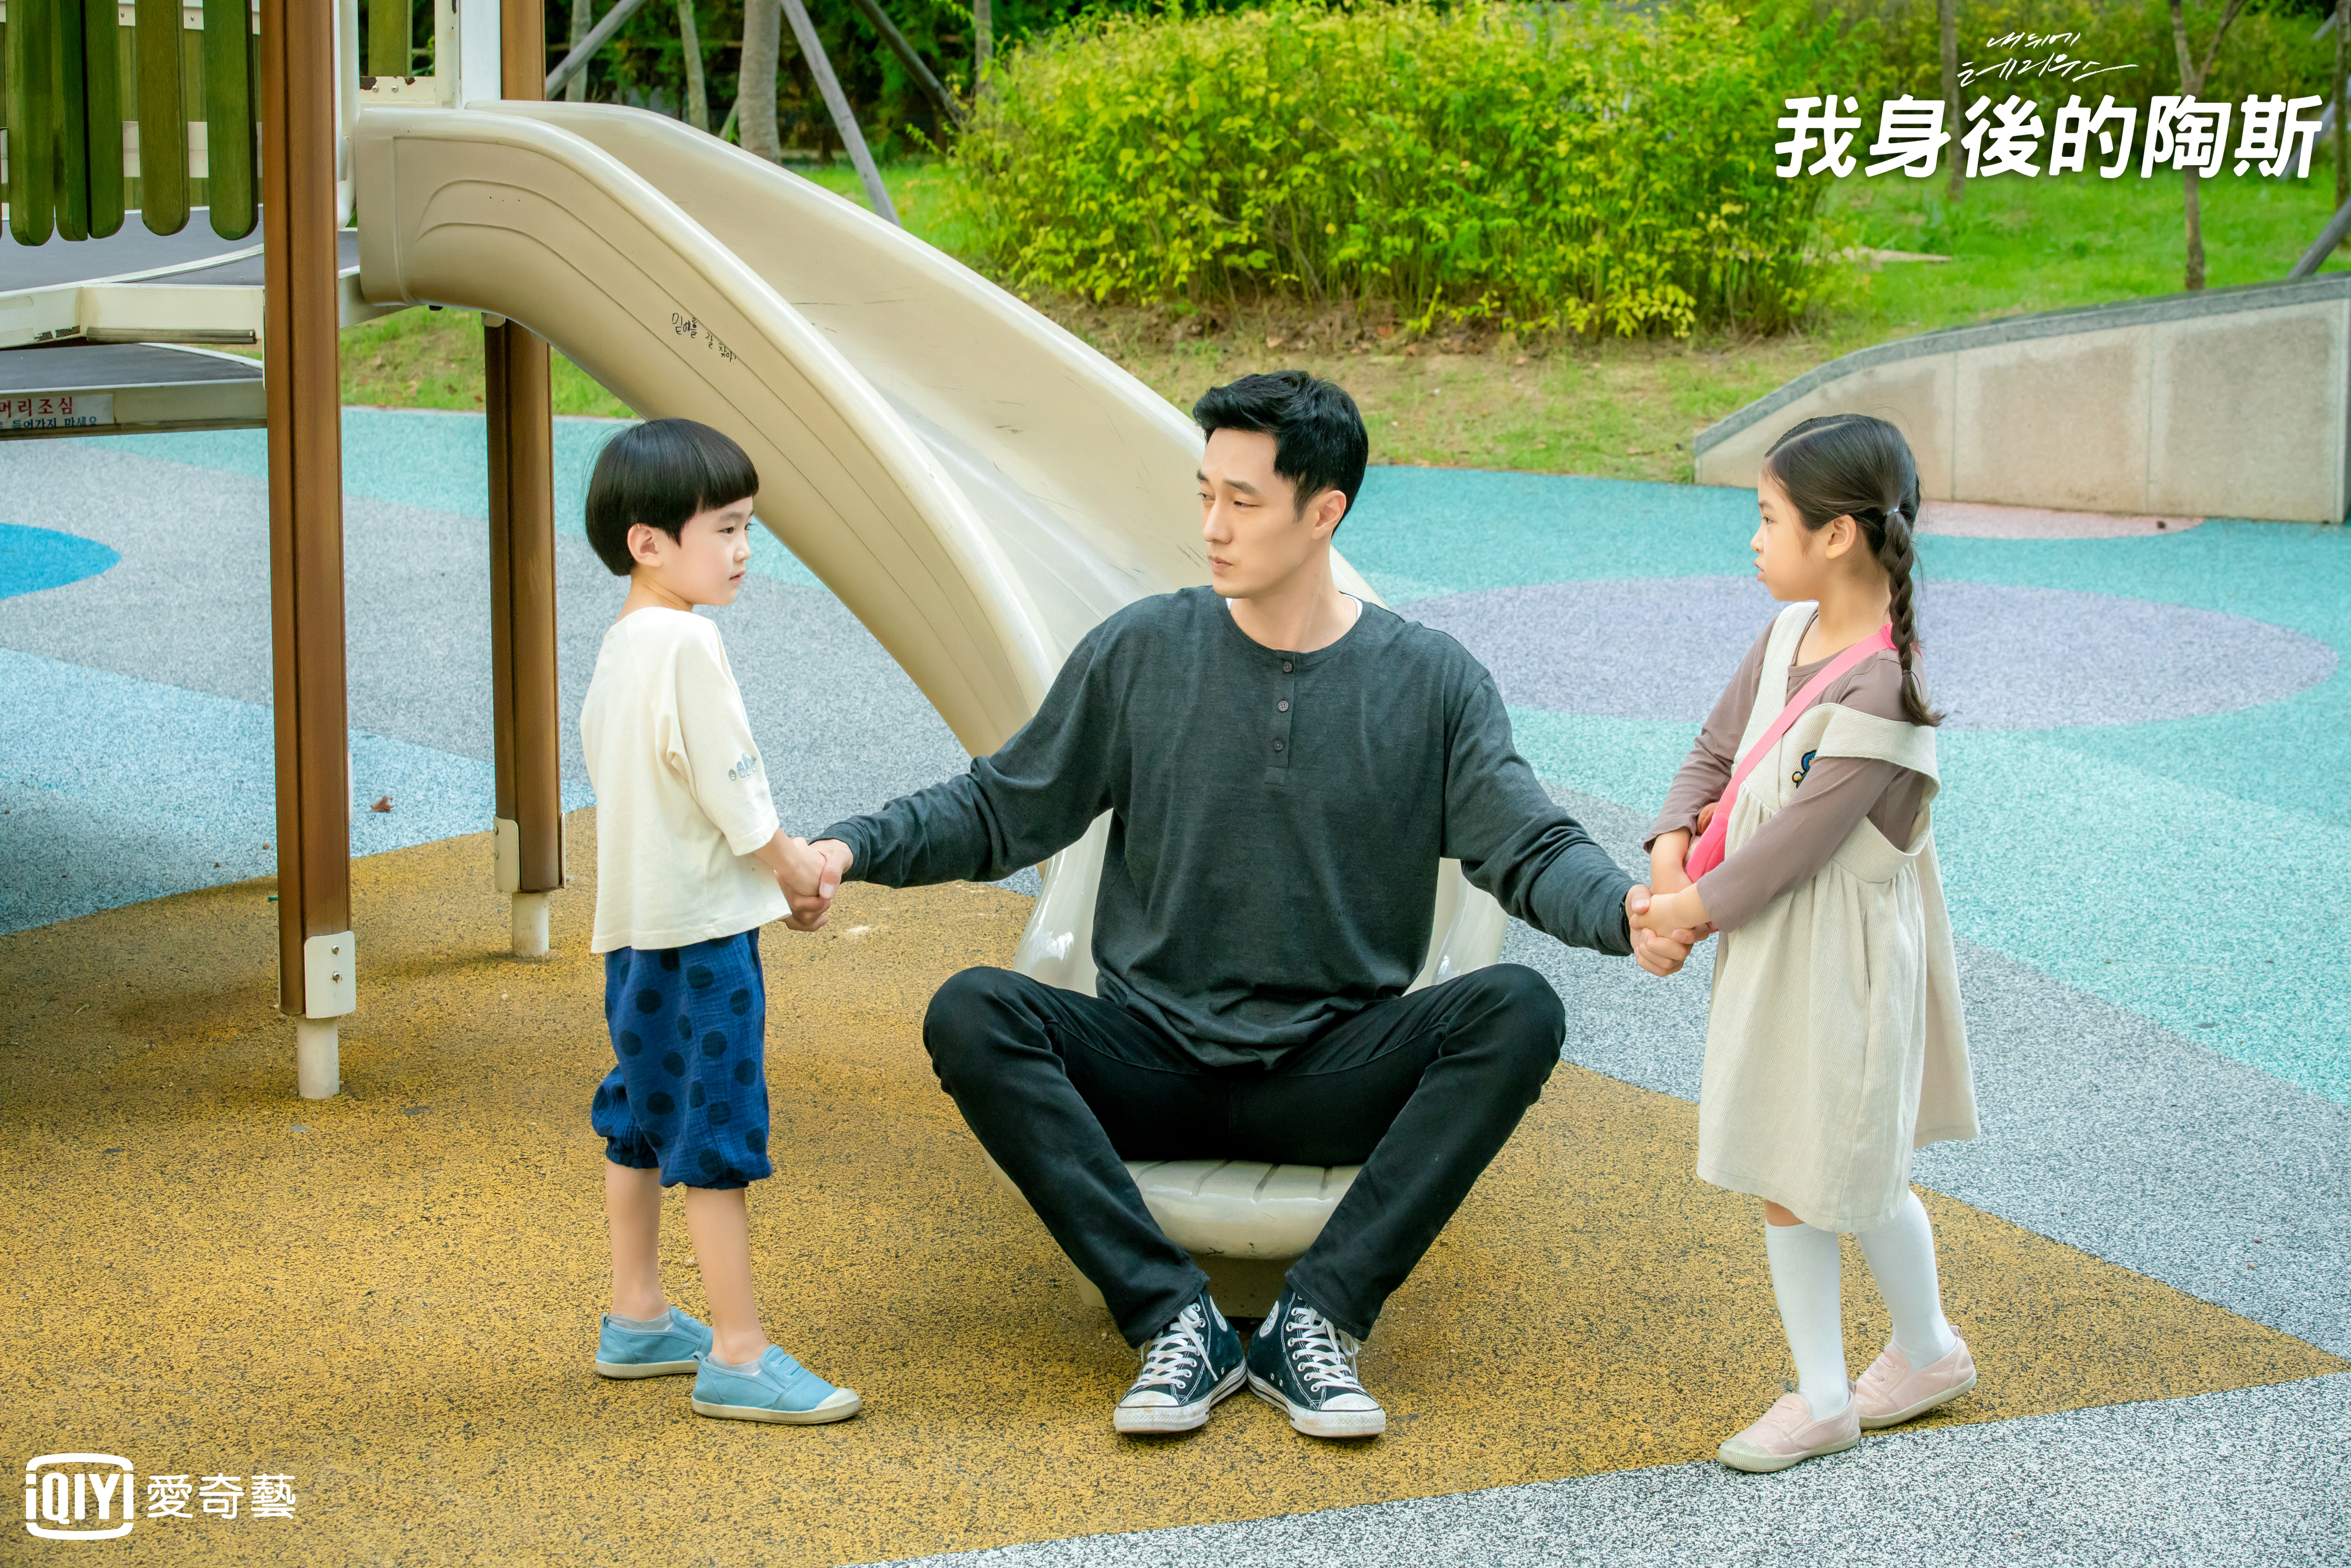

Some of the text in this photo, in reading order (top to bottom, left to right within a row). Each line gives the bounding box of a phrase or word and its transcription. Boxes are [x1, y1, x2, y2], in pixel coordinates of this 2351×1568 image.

[0, 396, 73, 418] 머리조심
[12, 417, 56, 430] 들어가지
[64, 416, 97, 428] 마세요
